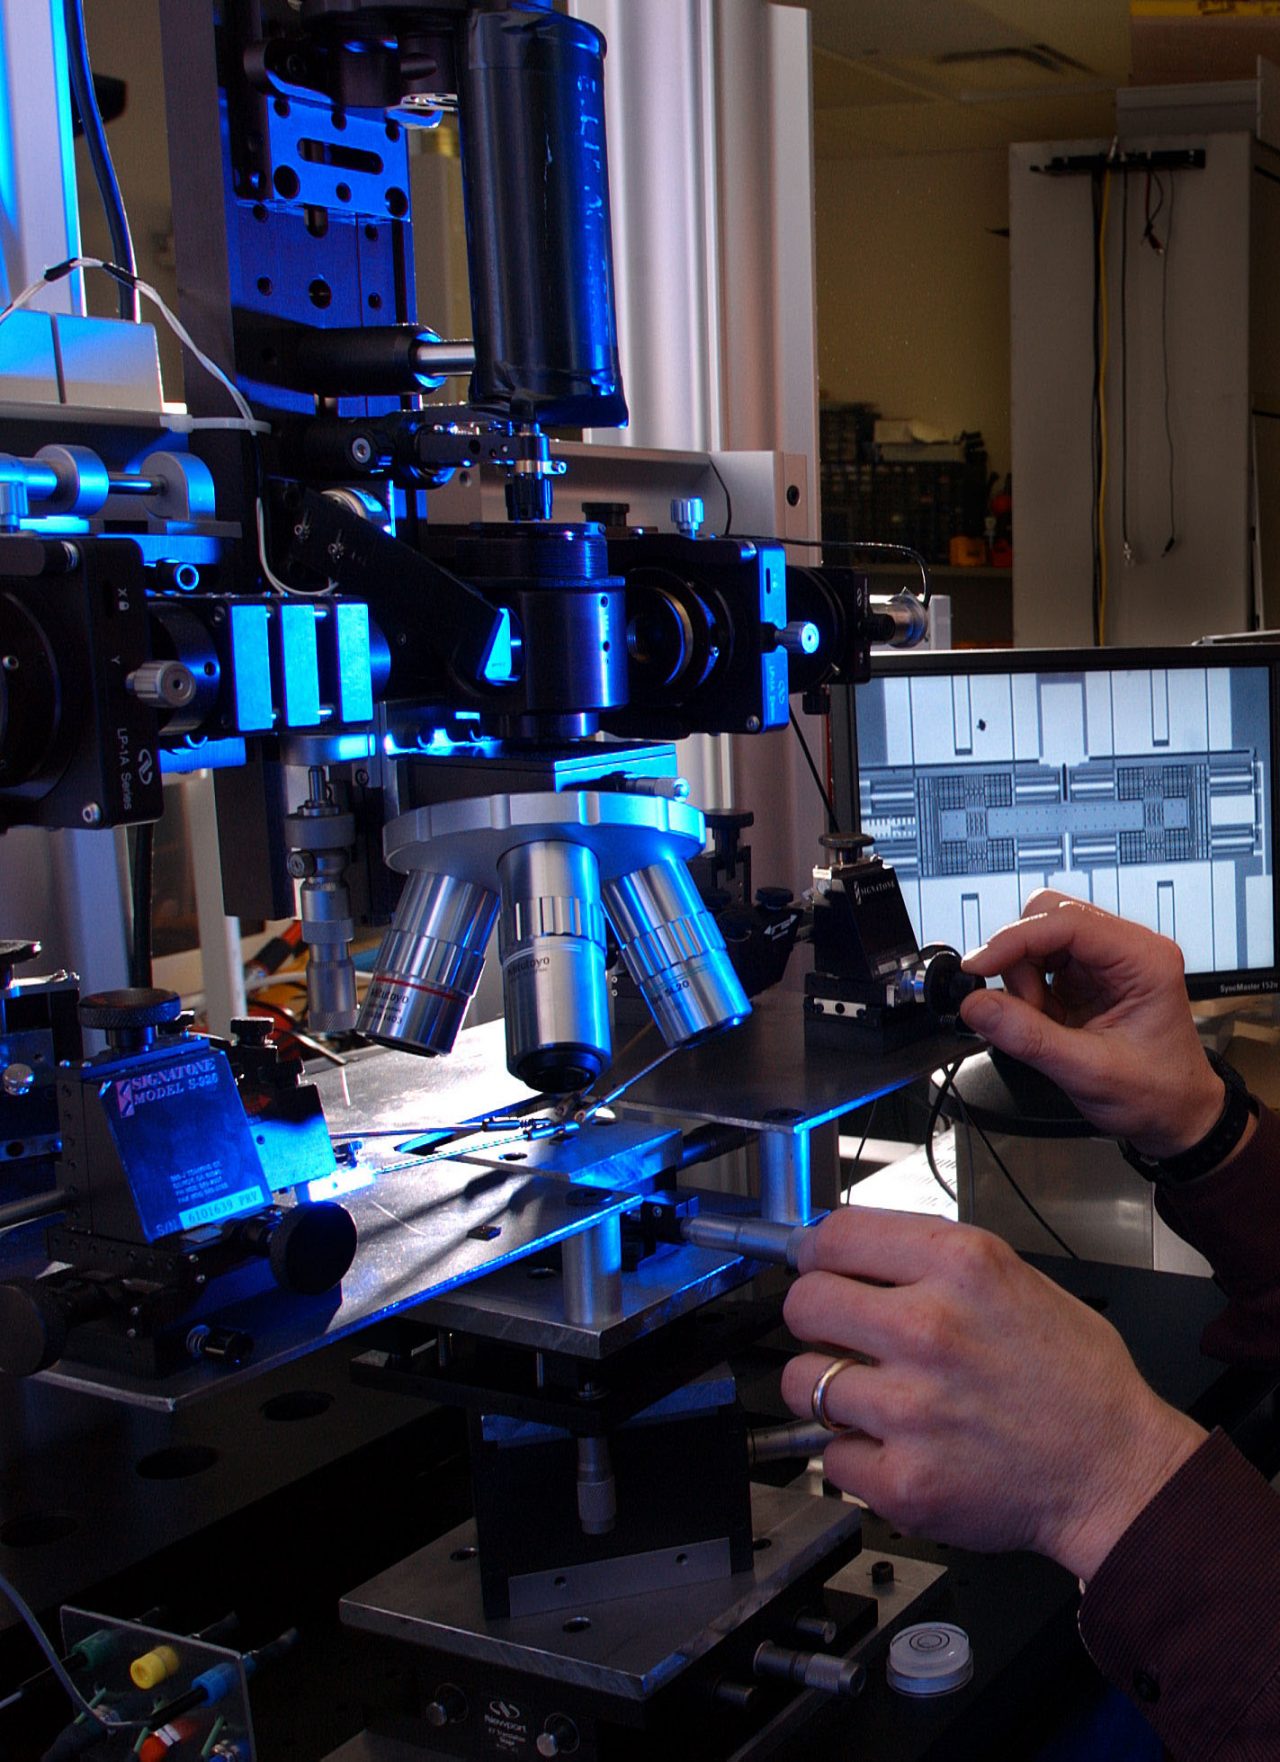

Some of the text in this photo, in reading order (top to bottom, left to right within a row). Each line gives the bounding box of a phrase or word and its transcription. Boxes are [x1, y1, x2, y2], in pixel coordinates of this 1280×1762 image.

[116, 727, 134, 811] LP-1A Series
[131, 1057, 216, 1091] SIGNATONE
[133, 1082, 185, 1106] MODEL
